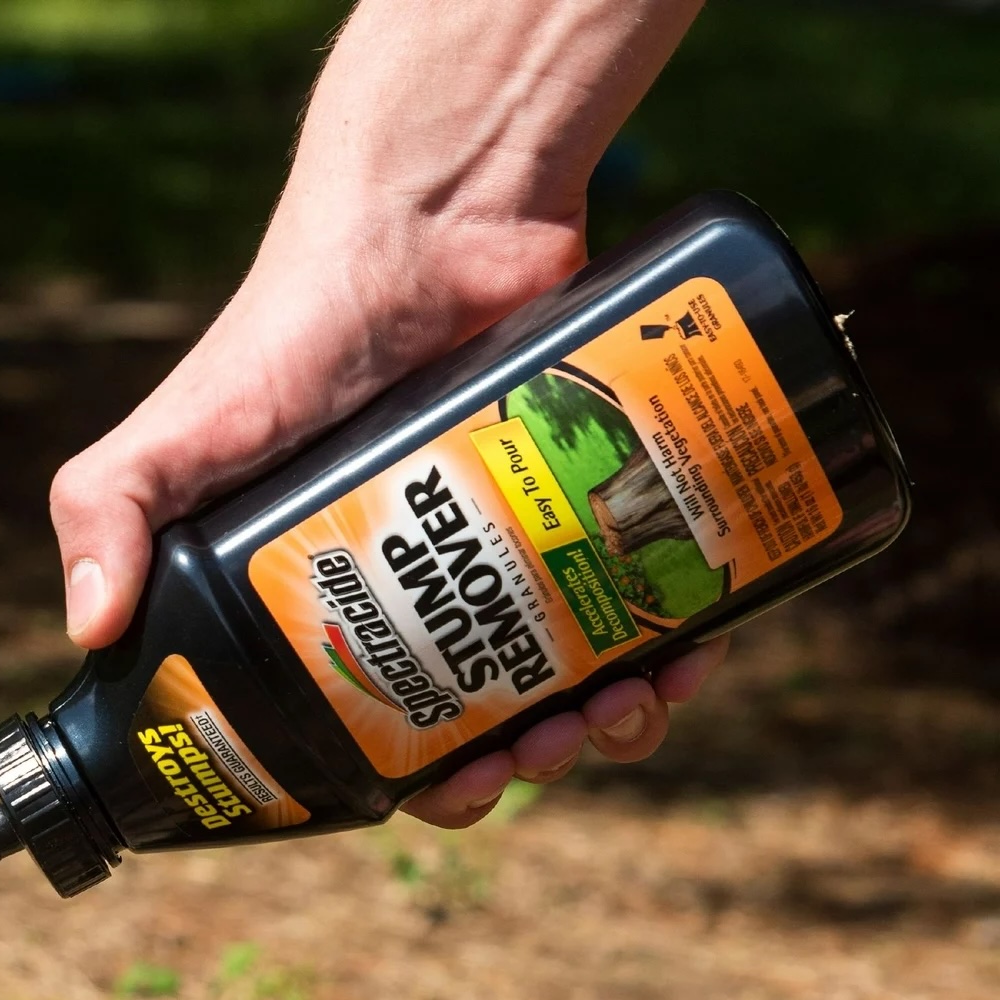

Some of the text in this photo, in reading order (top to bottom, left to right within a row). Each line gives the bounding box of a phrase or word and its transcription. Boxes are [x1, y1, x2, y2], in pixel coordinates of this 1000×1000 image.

[687, 298, 717, 342] EASY-TO-USE
[696, 293, 722, 330] GRANULES
[672, 370, 690, 388] LOS
[679, 383, 695, 396] DE
[647, 394, 692, 465] Vegetation
[499, 439, 561, 530] Easy To Pour
[652, 431, 703, 519] Will Not Harm
[685, 463, 731, 537] Surrounding
[382, 533, 497, 694] STUMP
[405, 464, 556, 695] REMOVER
[481, 520, 547, 622] GRANULES
[560, 566, 608, 633] Accelerates
[567, 548, 627, 640] Decomposition!
[314, 549, 462, 728] Spectracide
[136, 727, 231, 829] Destroys
[157, 722, 252, 819] Stumps!
[238, 771, 274, 802] RESULTS
